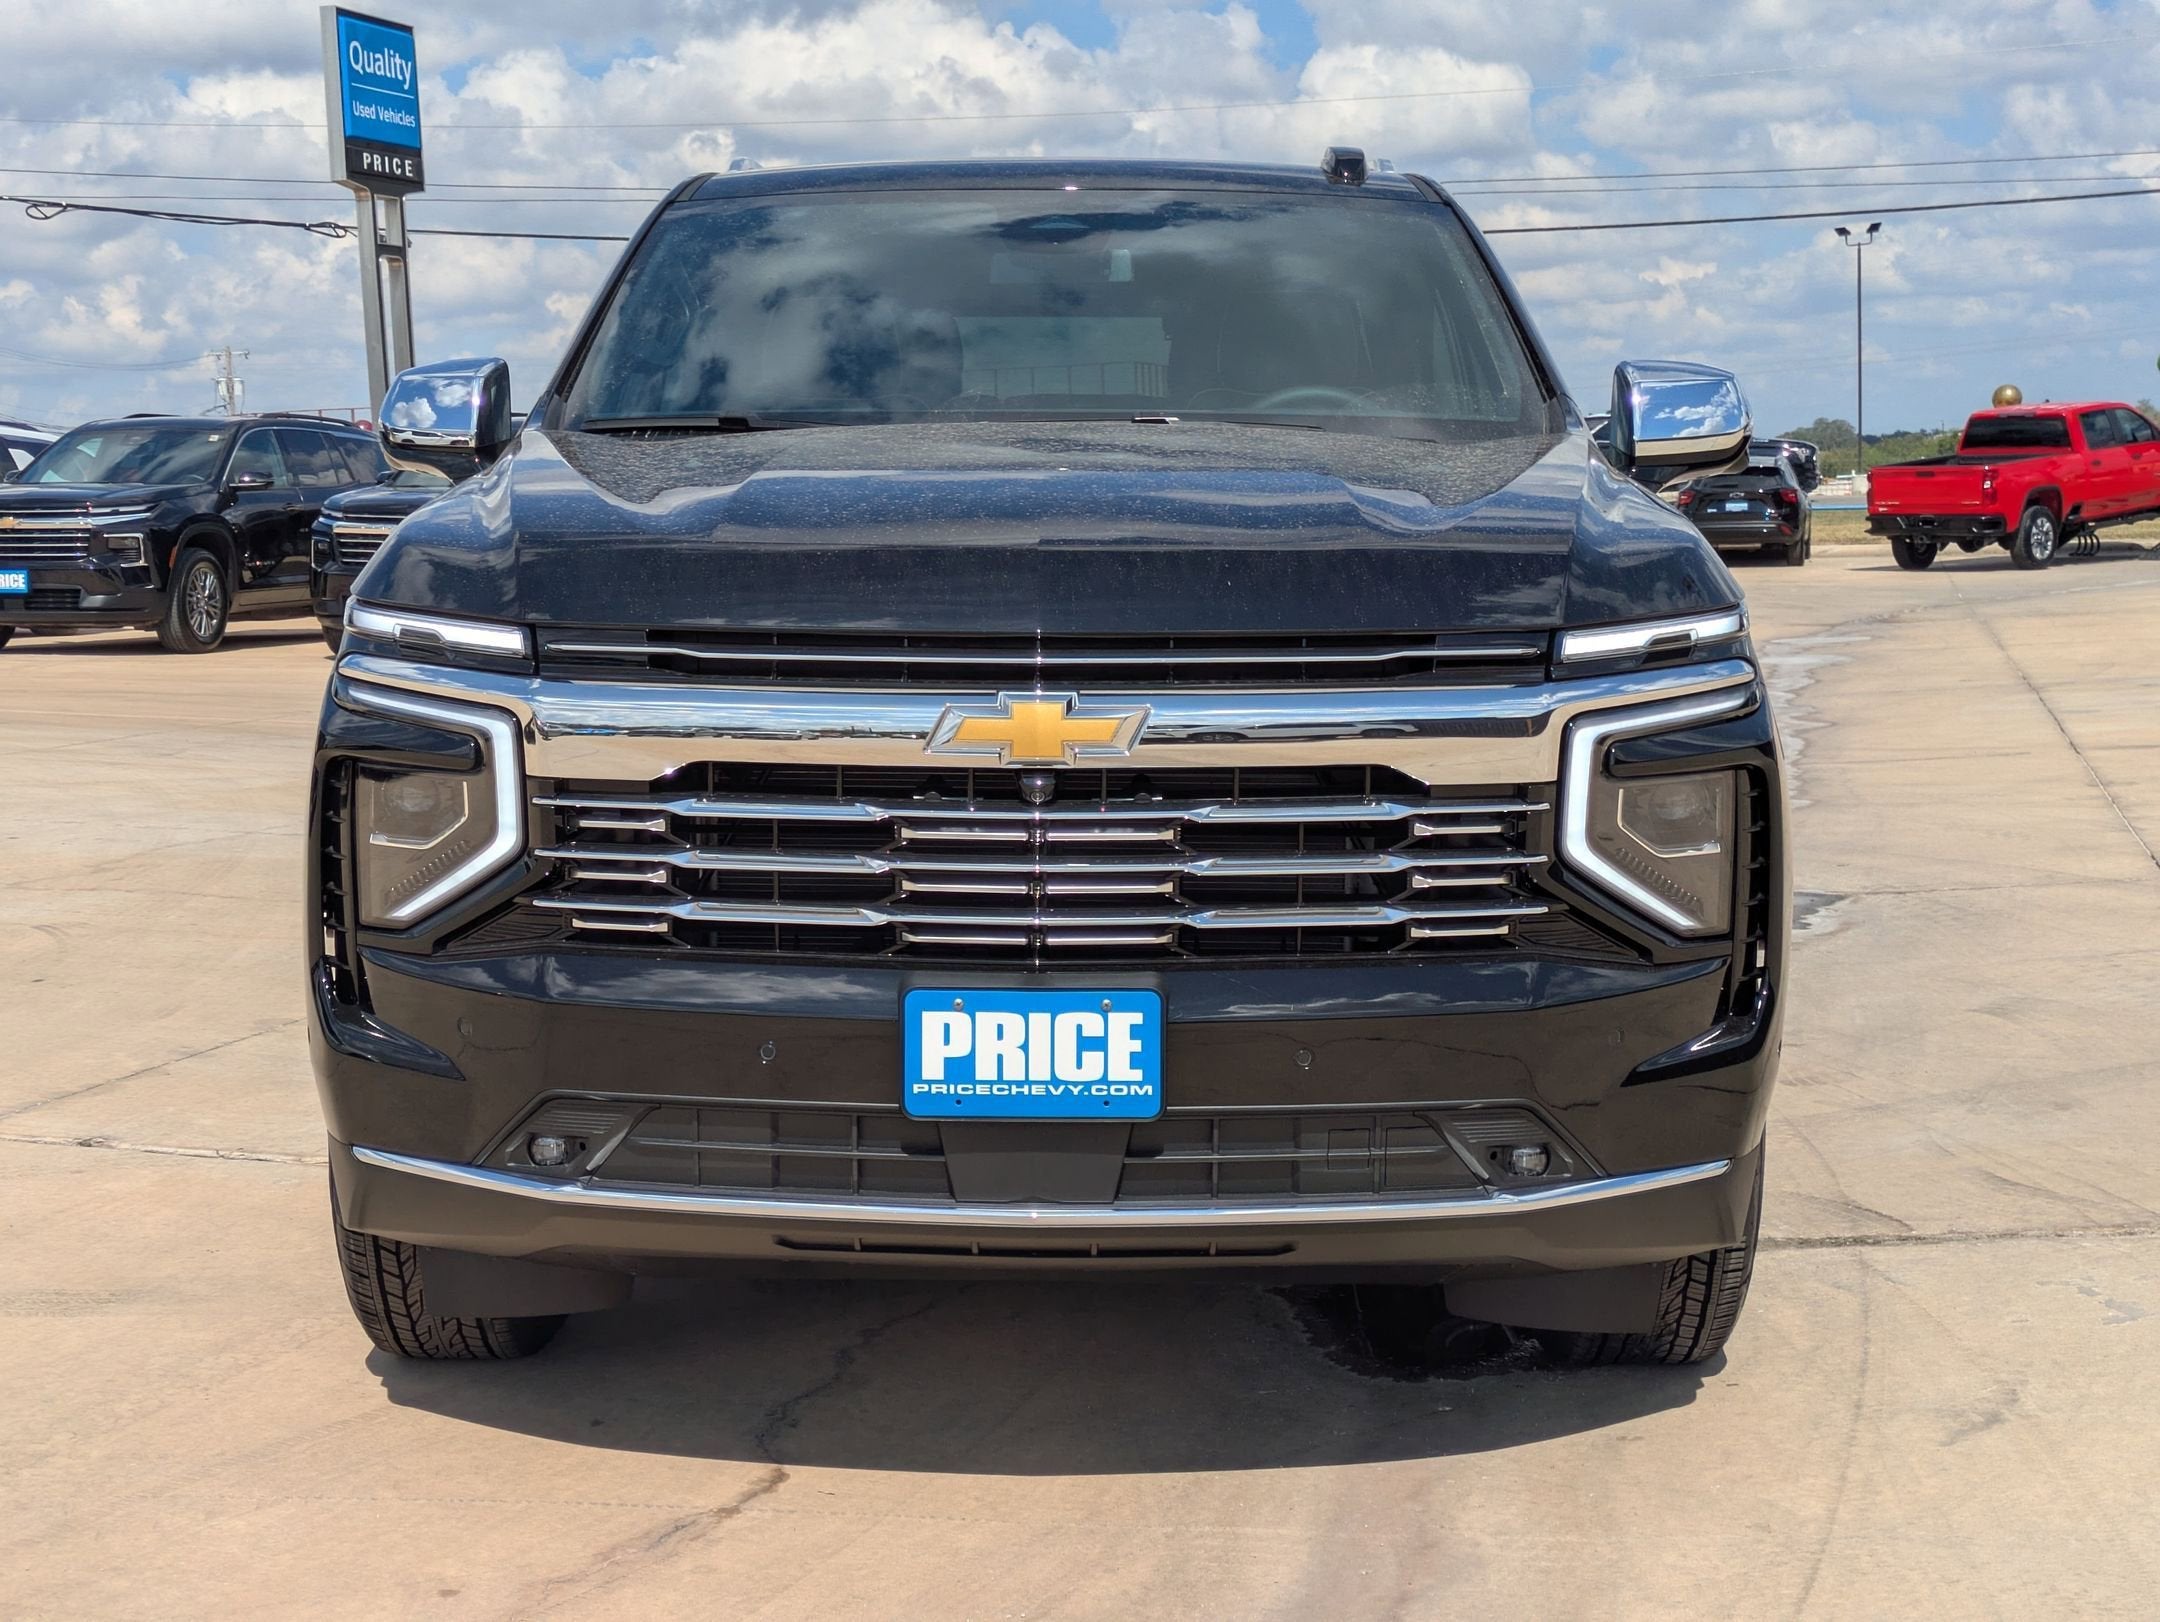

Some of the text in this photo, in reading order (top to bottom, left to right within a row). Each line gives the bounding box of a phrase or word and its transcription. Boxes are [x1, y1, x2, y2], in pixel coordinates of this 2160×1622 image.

[350, 40, 411, 90] Quality
[353, 100, 416, 127] Used Vehicles
[363, 152, 413, 177] PRICE
[921, 1011, 1143, 1082] PRICE
[913, 1083, 1153, 1096] PRICECHEVY.COM
